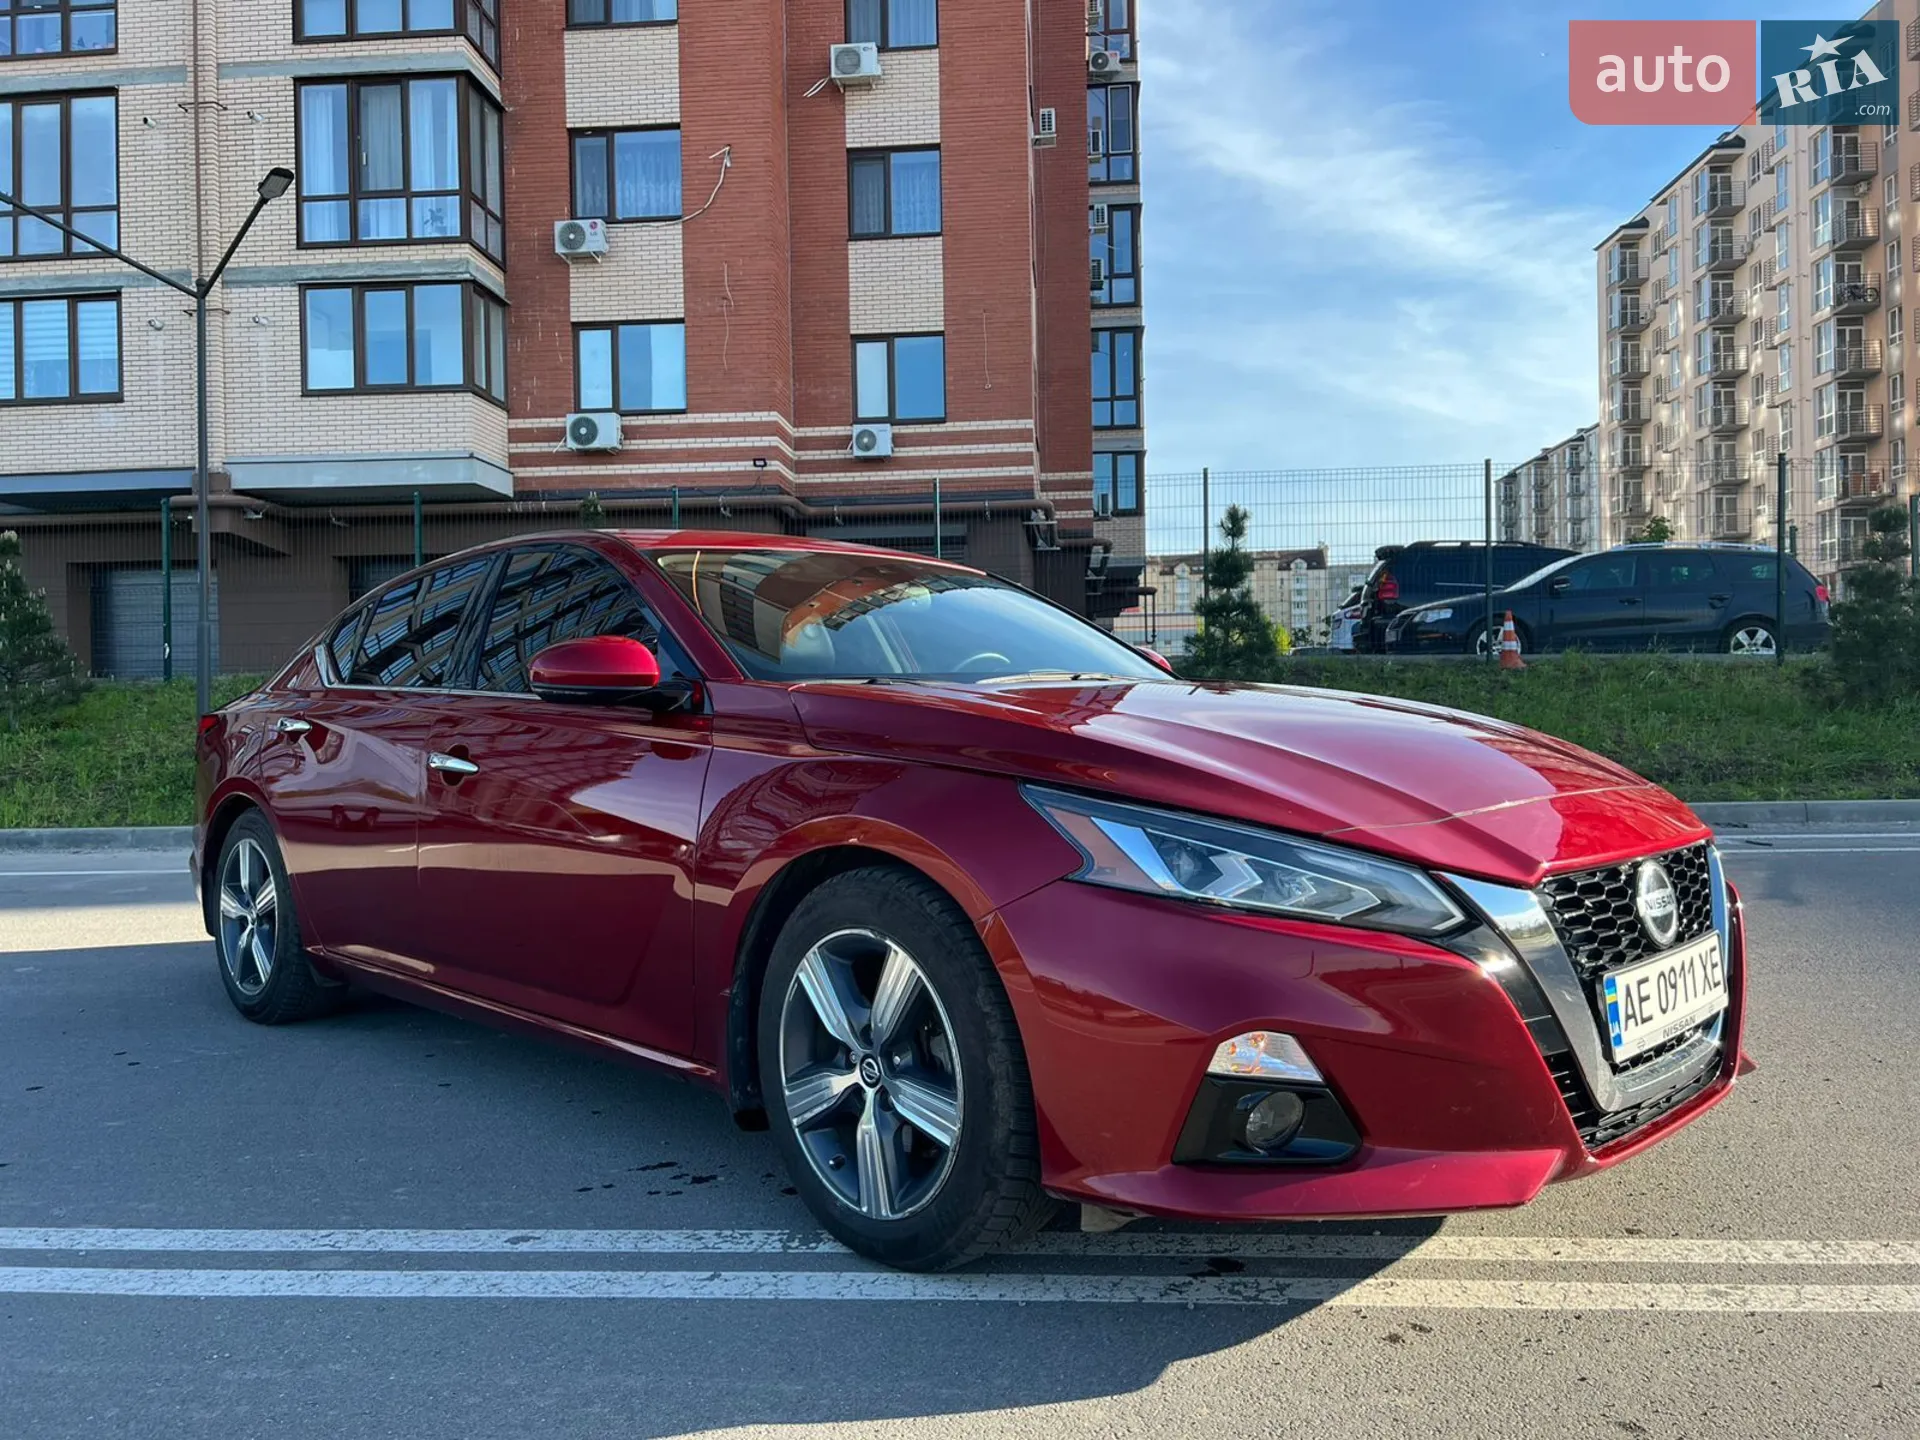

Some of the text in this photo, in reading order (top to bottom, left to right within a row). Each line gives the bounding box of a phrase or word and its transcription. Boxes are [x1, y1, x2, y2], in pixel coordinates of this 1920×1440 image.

[1644, 894, 1675, 911] NISSAN
[1624, 945, 1721, 1032] AE 0911 XE
[1662, 1014, 1697, 1039] NISSAN
